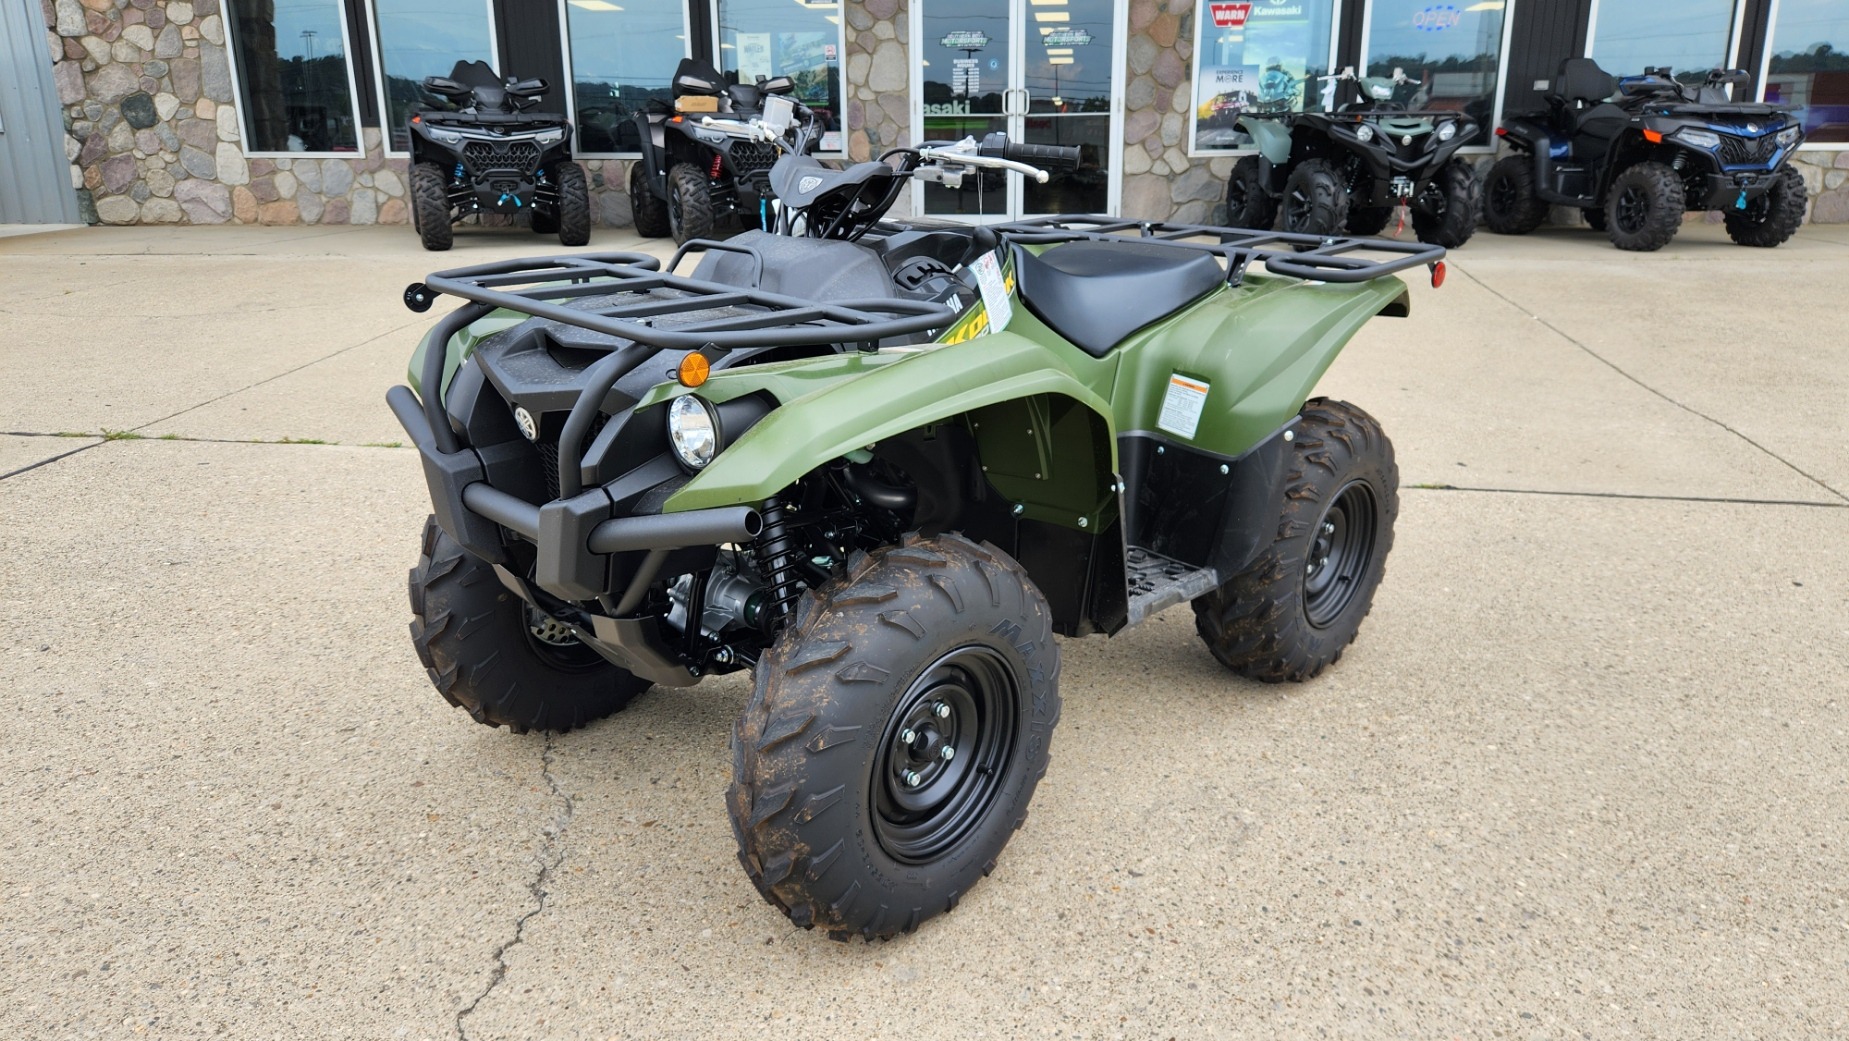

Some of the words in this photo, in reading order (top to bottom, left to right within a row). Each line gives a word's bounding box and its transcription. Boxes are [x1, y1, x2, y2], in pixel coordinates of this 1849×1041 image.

[1215, 10, 1246, 20] WARN
[1253, 5, 1302, 16] Kawasaki
[1412, 11, 1460, 26] OPEN
[989, 618, 1047, 761] MAXXIS
